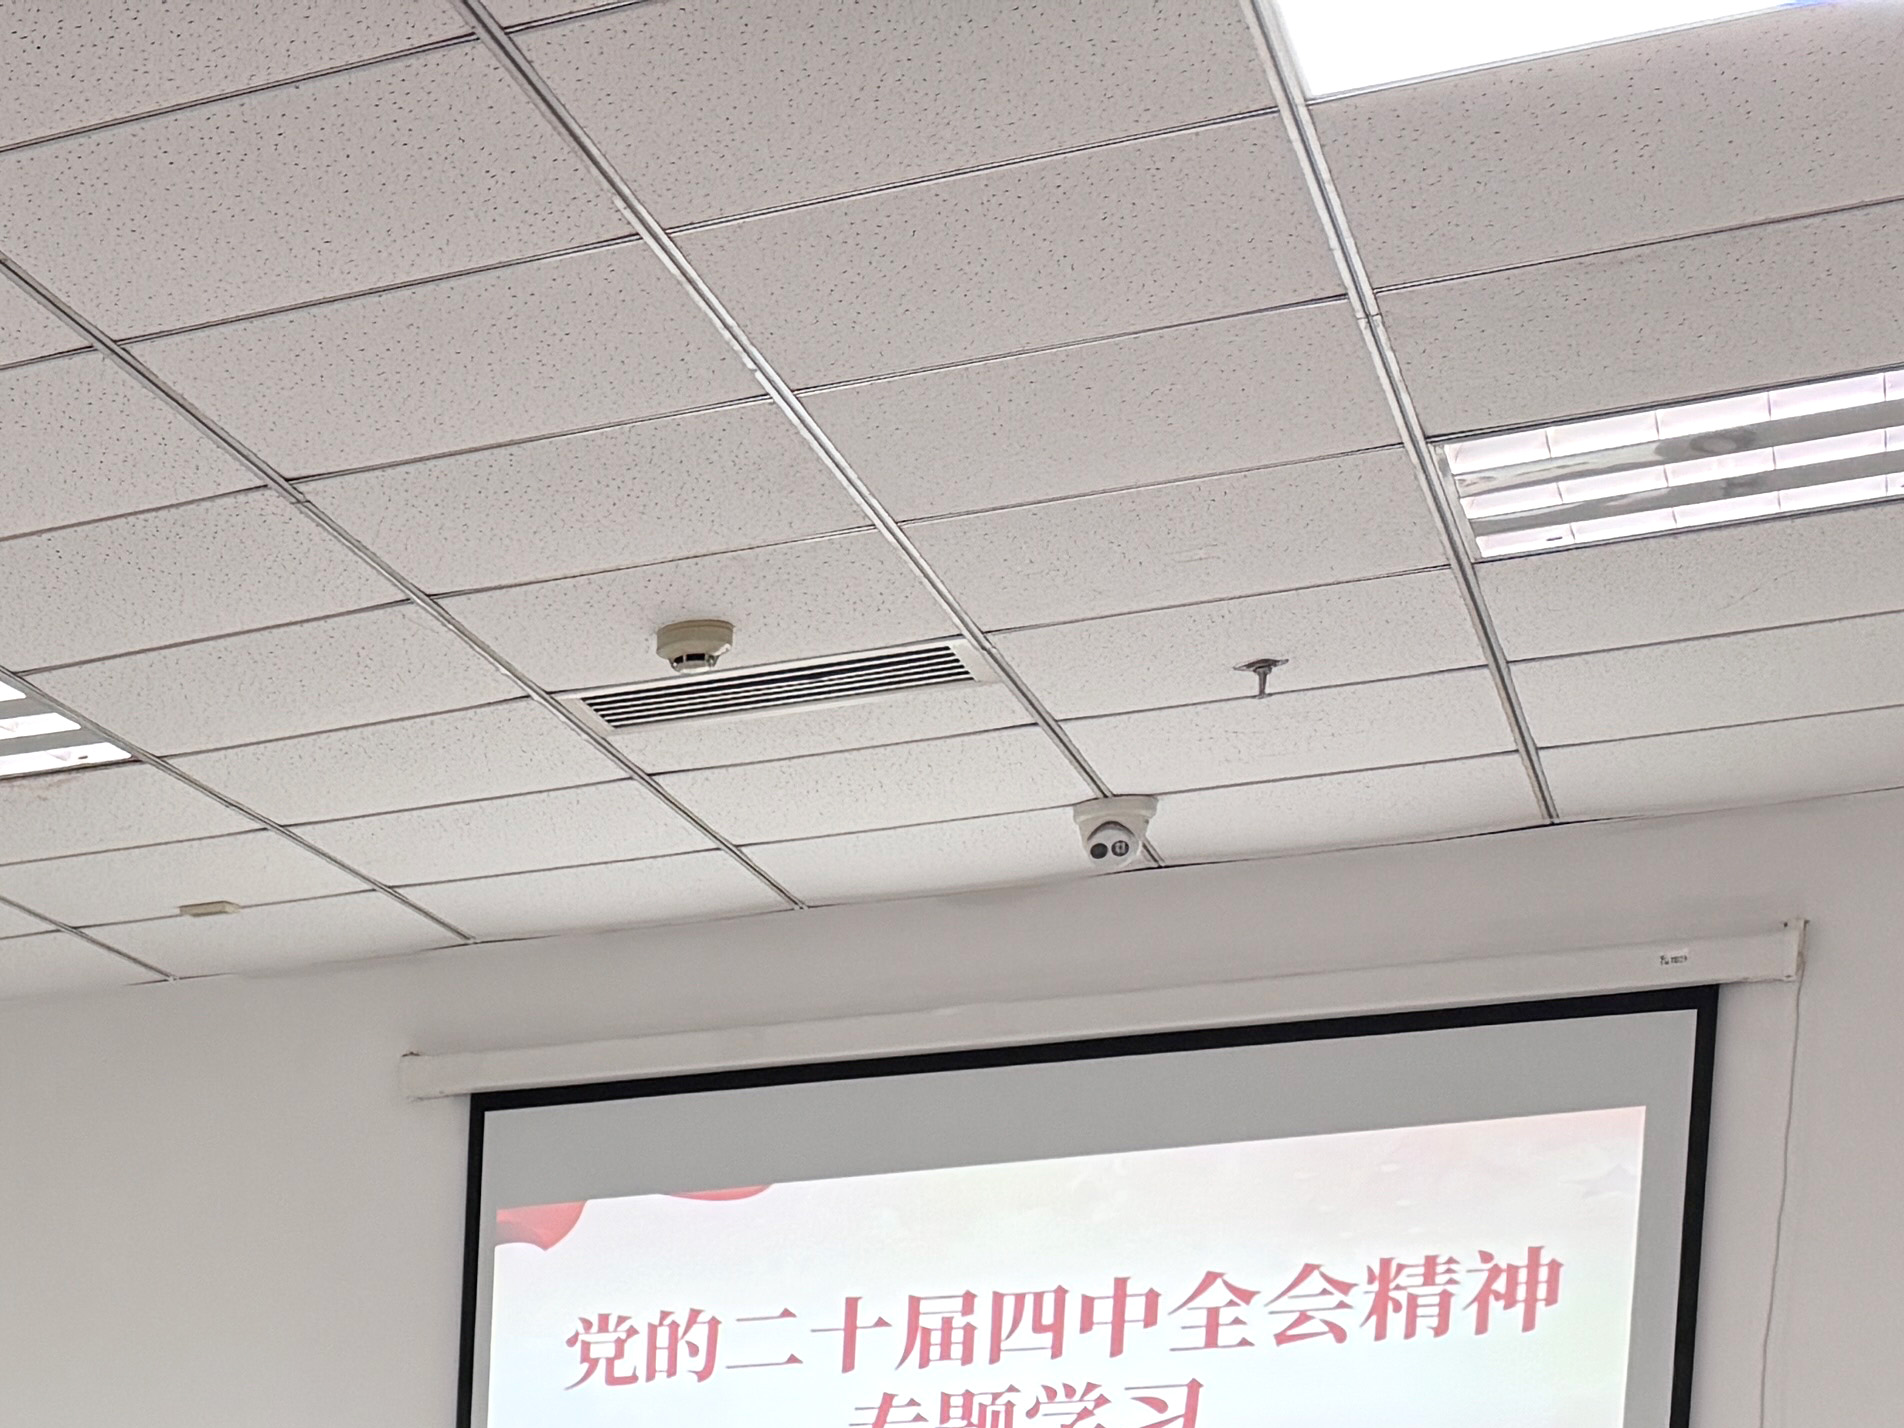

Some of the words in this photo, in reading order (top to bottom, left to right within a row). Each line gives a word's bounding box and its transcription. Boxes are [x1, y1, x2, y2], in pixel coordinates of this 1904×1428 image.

[565, 1245, 1564, 1391] 党的二十届四中全会精神
